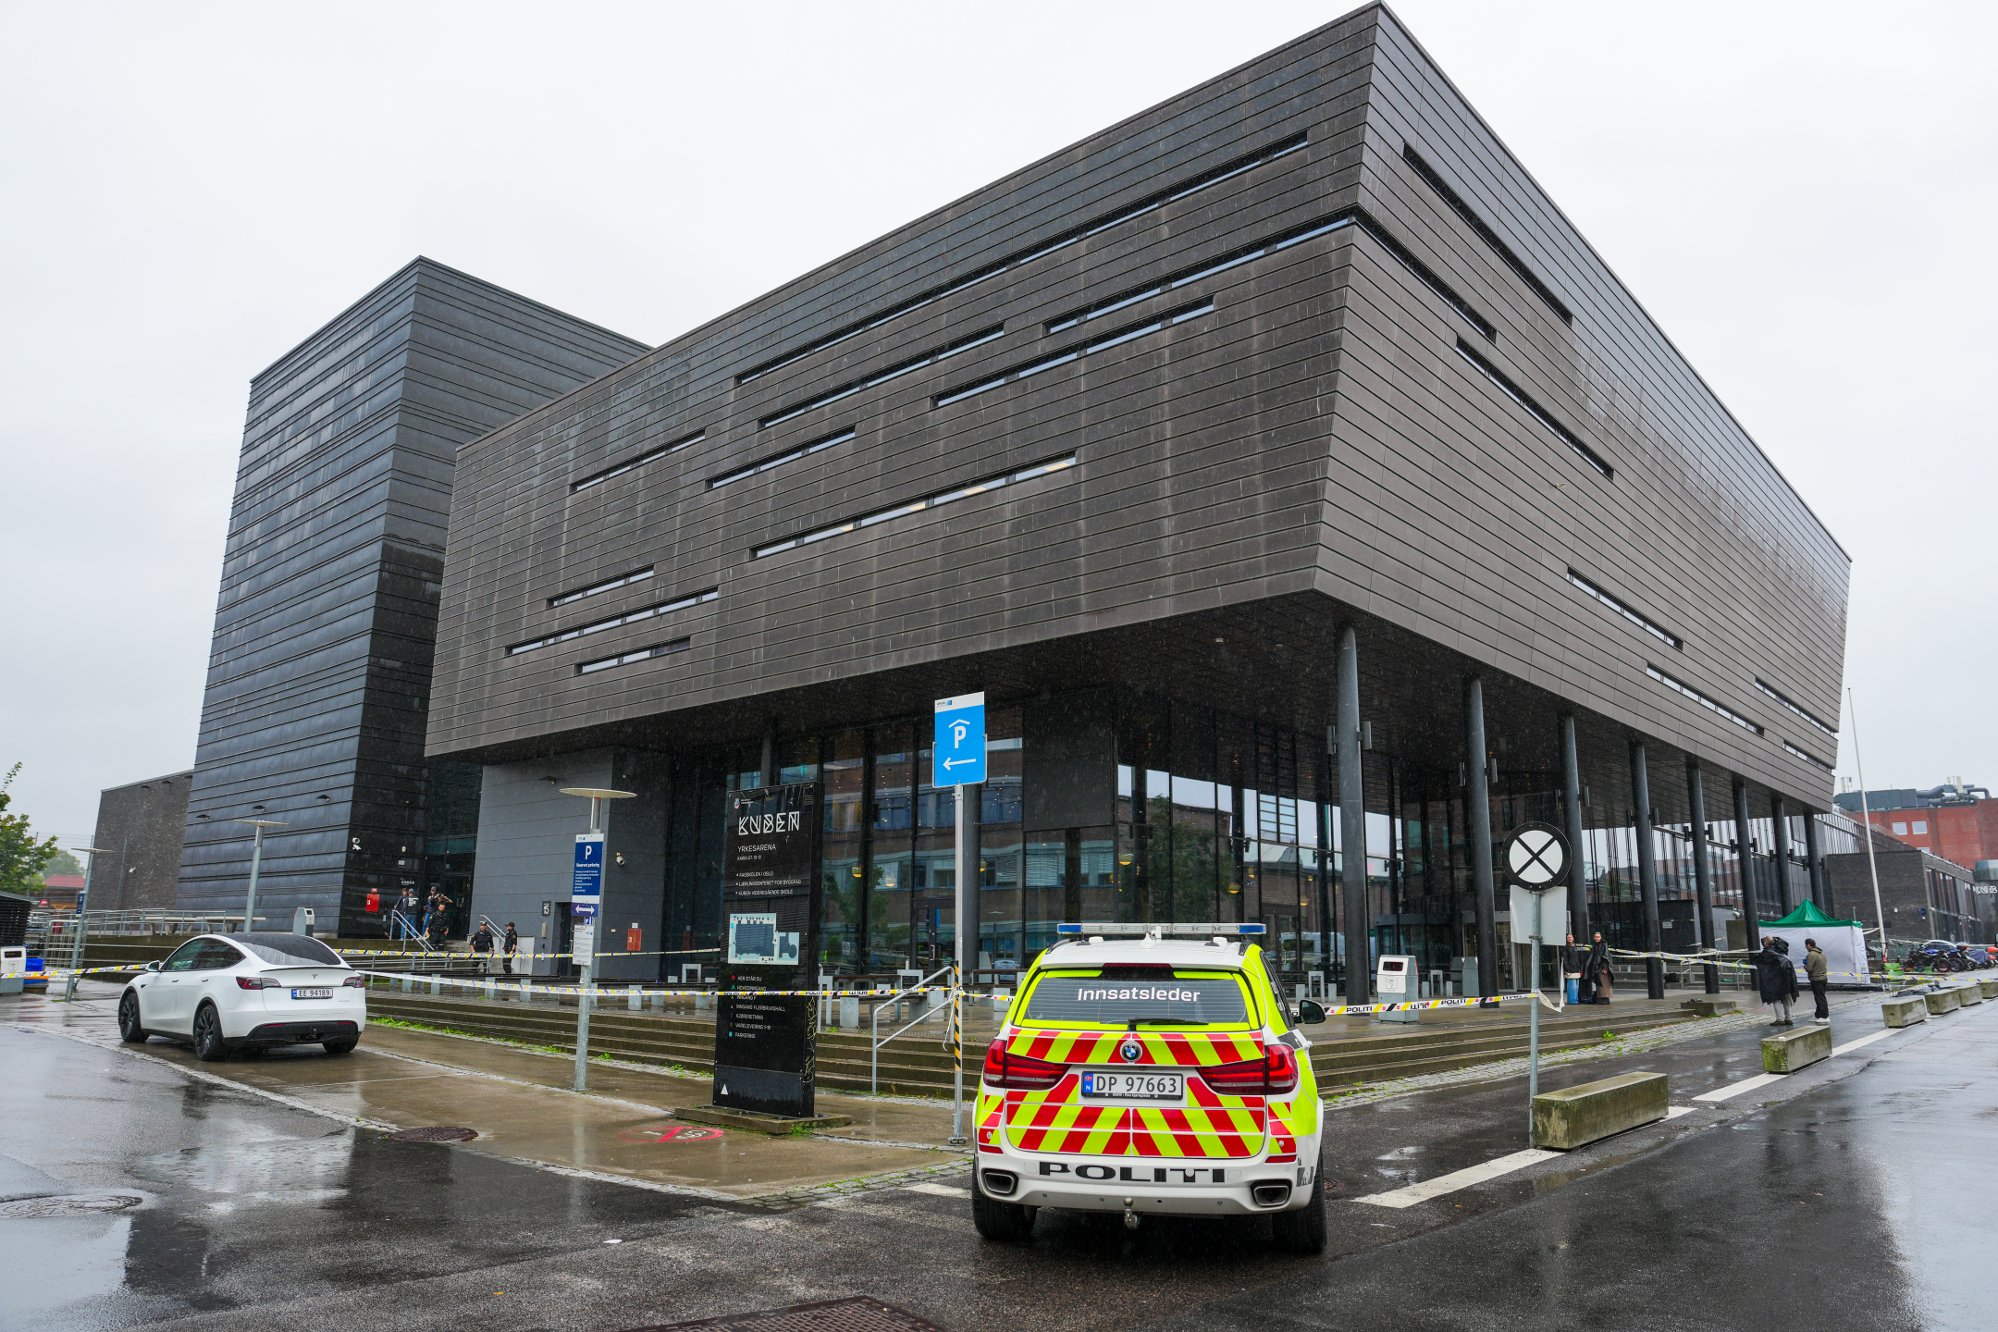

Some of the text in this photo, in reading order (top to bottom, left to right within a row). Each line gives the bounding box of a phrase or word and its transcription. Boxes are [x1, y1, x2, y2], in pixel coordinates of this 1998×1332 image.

[954, 725, 967, 749] P
[738, 811, 800, 836] KUBEN
[585, 845, 592, 860] P
[738, 844, 777, 853] YRKESARENA
[310, 989, 330, 997] 94189
[1077, 986, 1200, 1002] Innsatsleder
[1096, 1076, 1117, 1092] DP
[1125, 1076, 1177, 1093] 97663
[1039, 1161, 1225, 1183] POLITI
